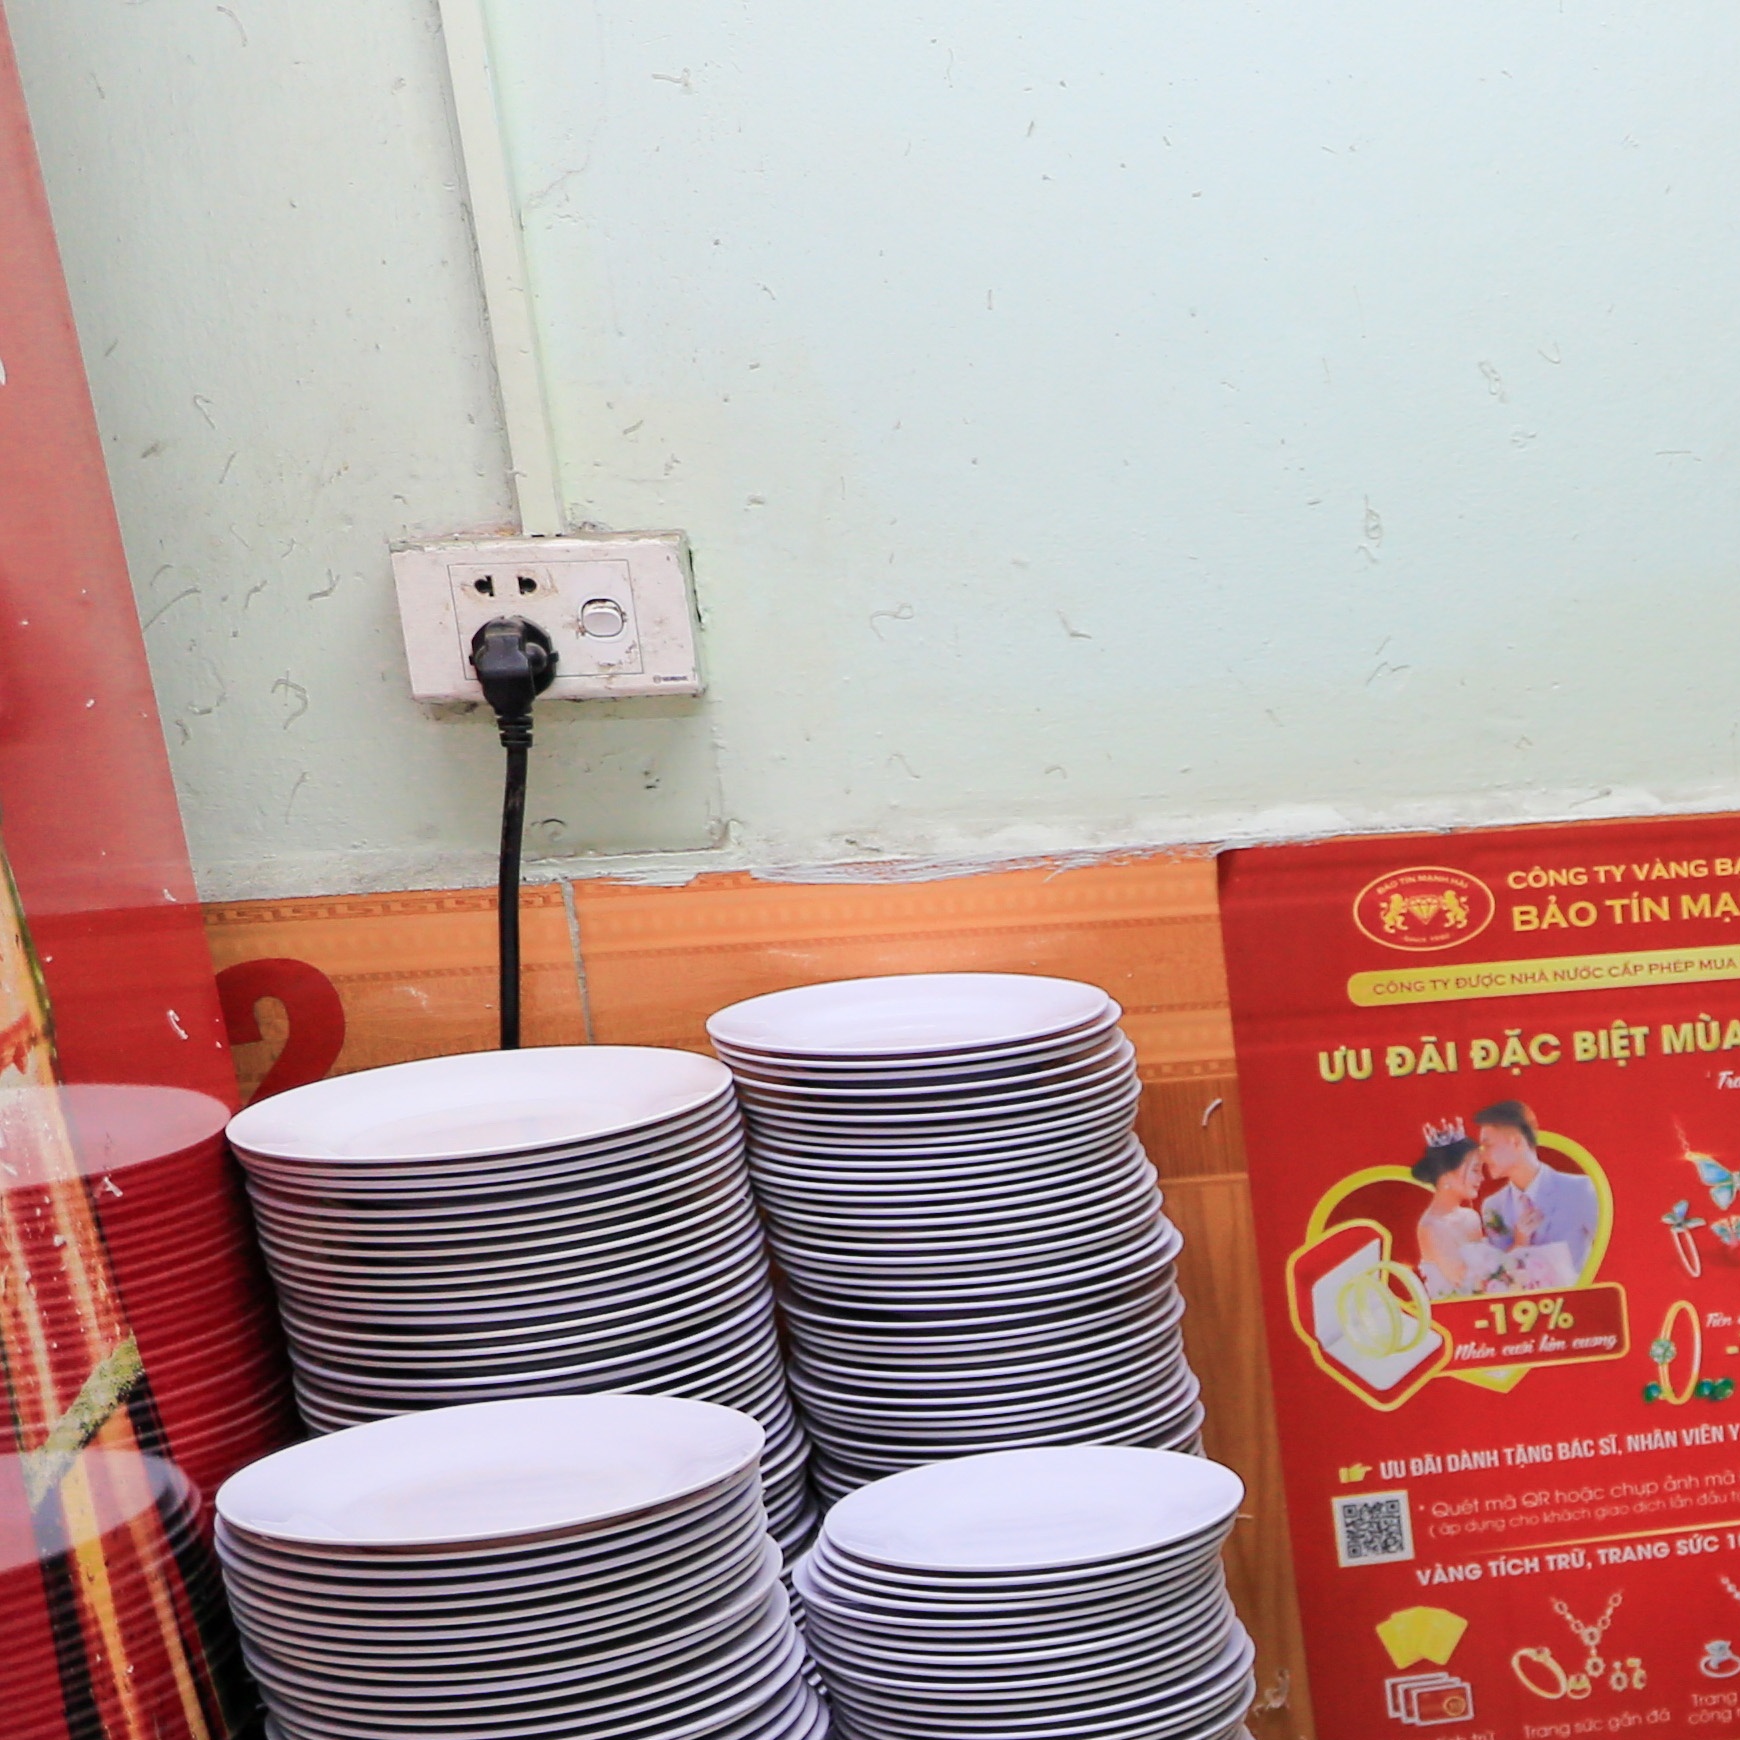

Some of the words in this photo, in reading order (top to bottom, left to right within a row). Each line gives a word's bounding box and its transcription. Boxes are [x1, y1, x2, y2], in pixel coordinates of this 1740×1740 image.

[1507, 866, 1588, 889] CÔNG
[1594, 864, 1626, 883] TY
[1632, 858, 1709, 881] VÀNG
[1513, 895, 1598, 932] BẢO
[1605, 892, 1671, 924] TÍN
[1373, 980, 1425, 995] CÔNG
[1431, 979, 1451, 992] TY
[1455, 973, 1506, 990] ĐƯỢC
[1511, 969, 1548, 985] NHÀ
[1554, 964, 1603, 982] NƯỚC
[1609, 961, 1641, 978] CẤP
[1649, 958, 1694, 975] PHÉP
[1700, 958, 1737, 970] MUA
[1319, 1046, 1374, 1082] ƯU
[1385, 1036, 1458, 1077] ĐÃI
[1470, 1028, 1562, 1076] ĐẶC
[1573, 1019, 1650, 1067] BIỆT
[1475, 1297, 1574, 1335] -19%
[1380, 1458, 1406, 1480] ƯU
[1410, 1454, 1442, 1477] ĐÃI
[1447, 1448, 1499, 1473] DÀNH
[1504, 1444, 1553, 1468] TẶNG
[1557, 1437, 1594, 1463] BÁC
[1626, 1429, 1678, 1453] NHÂN
[1682, 1424, 1725, 1447] VIÊN
[1432, 1499, 1480, 1519] Quét
[1522, 1491, 1551, 1507] QR
[1555, 1484, 1604, 1503] hoặc
[1610, 1479, 1659, 1499] chụp
[1416, 1560, 1483, 1586] VÀNG
[1488, 1554, 1540, 1578] TÍCH
[1597, 1541, 1670, 1565] TRANG
[1676, 1533, 1720, 1557] SỨC
[1523, 1722, 1572, 1740] Trang
